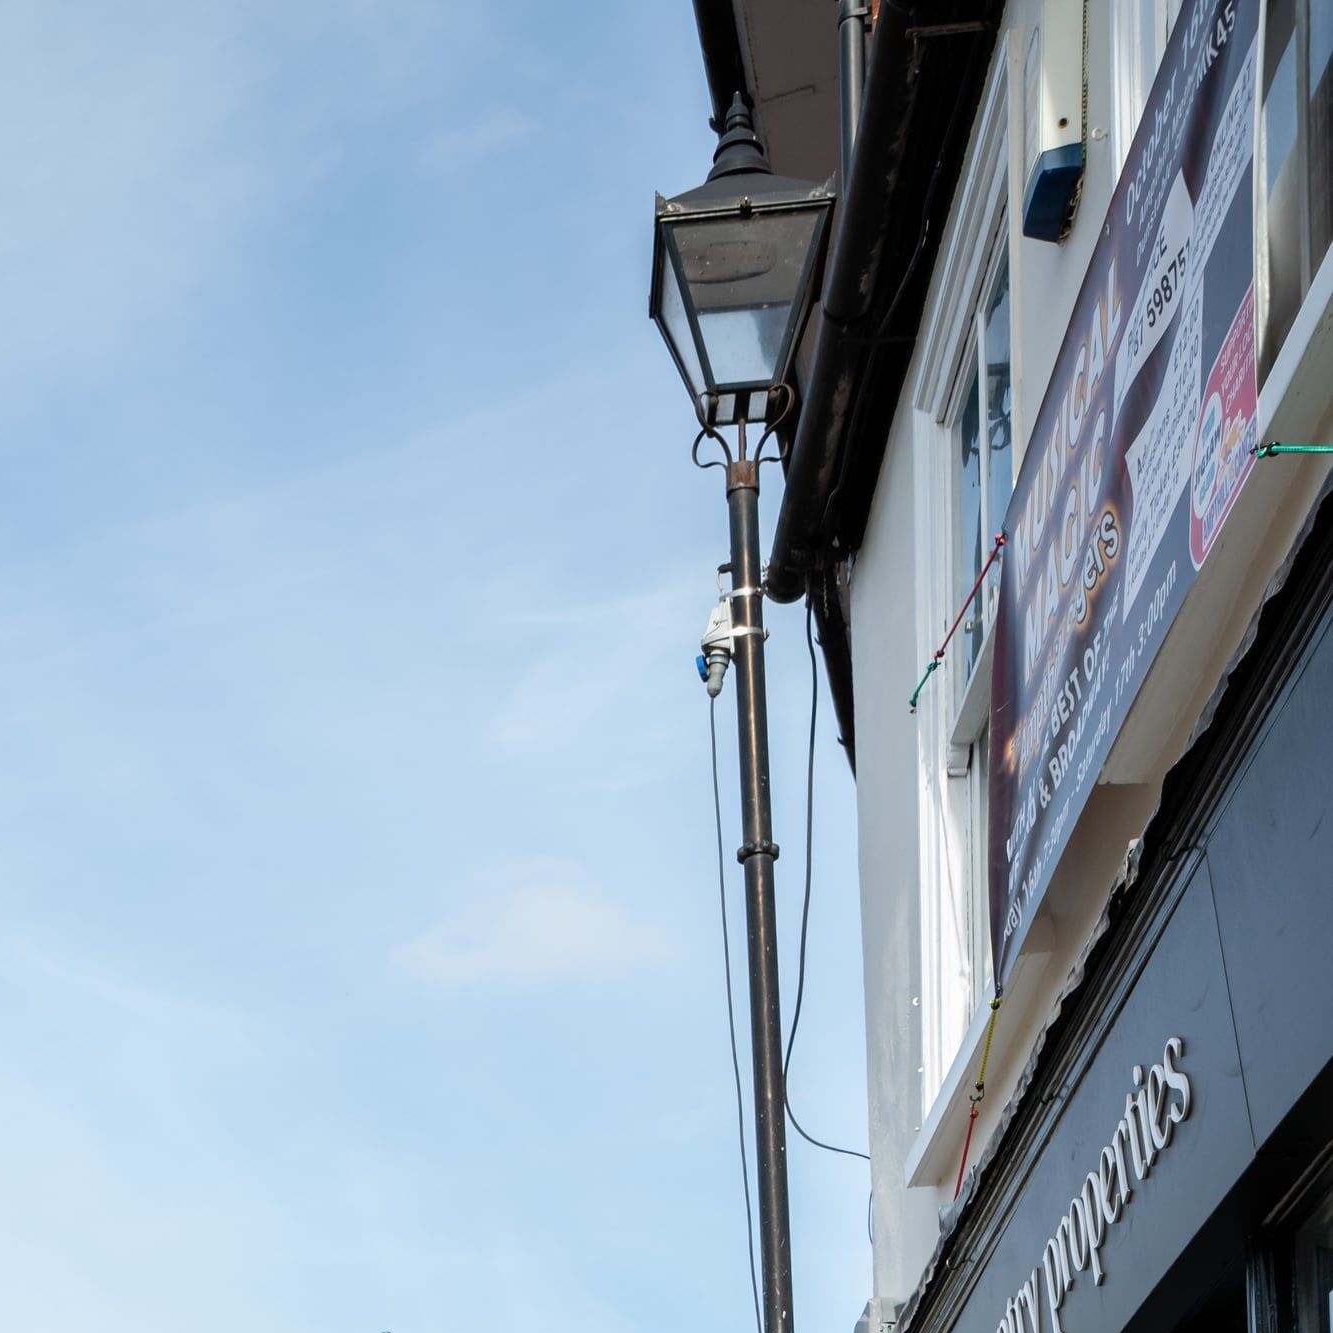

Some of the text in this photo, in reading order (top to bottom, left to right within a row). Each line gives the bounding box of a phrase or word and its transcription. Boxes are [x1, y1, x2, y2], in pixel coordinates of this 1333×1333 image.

[1126, 68, 1177, 226] October
[1147, 236, 1191, 328] 598751
[1014, 255, 1121, 601] MUSICAL
[1024, 411, 1105, 688] MAGIC
[1022, 857, 1042, 904] 16th
[1076, 697, 1113, 793] Saturday
[1115, 646, 1136, 706] 17th
[1138, 560, 1177, 656] 3:00pm
[1051, 667, 1082, 738] BEST
[1084, 632, 1101, 682] OF
[1038, 777, 1051, 809] &
